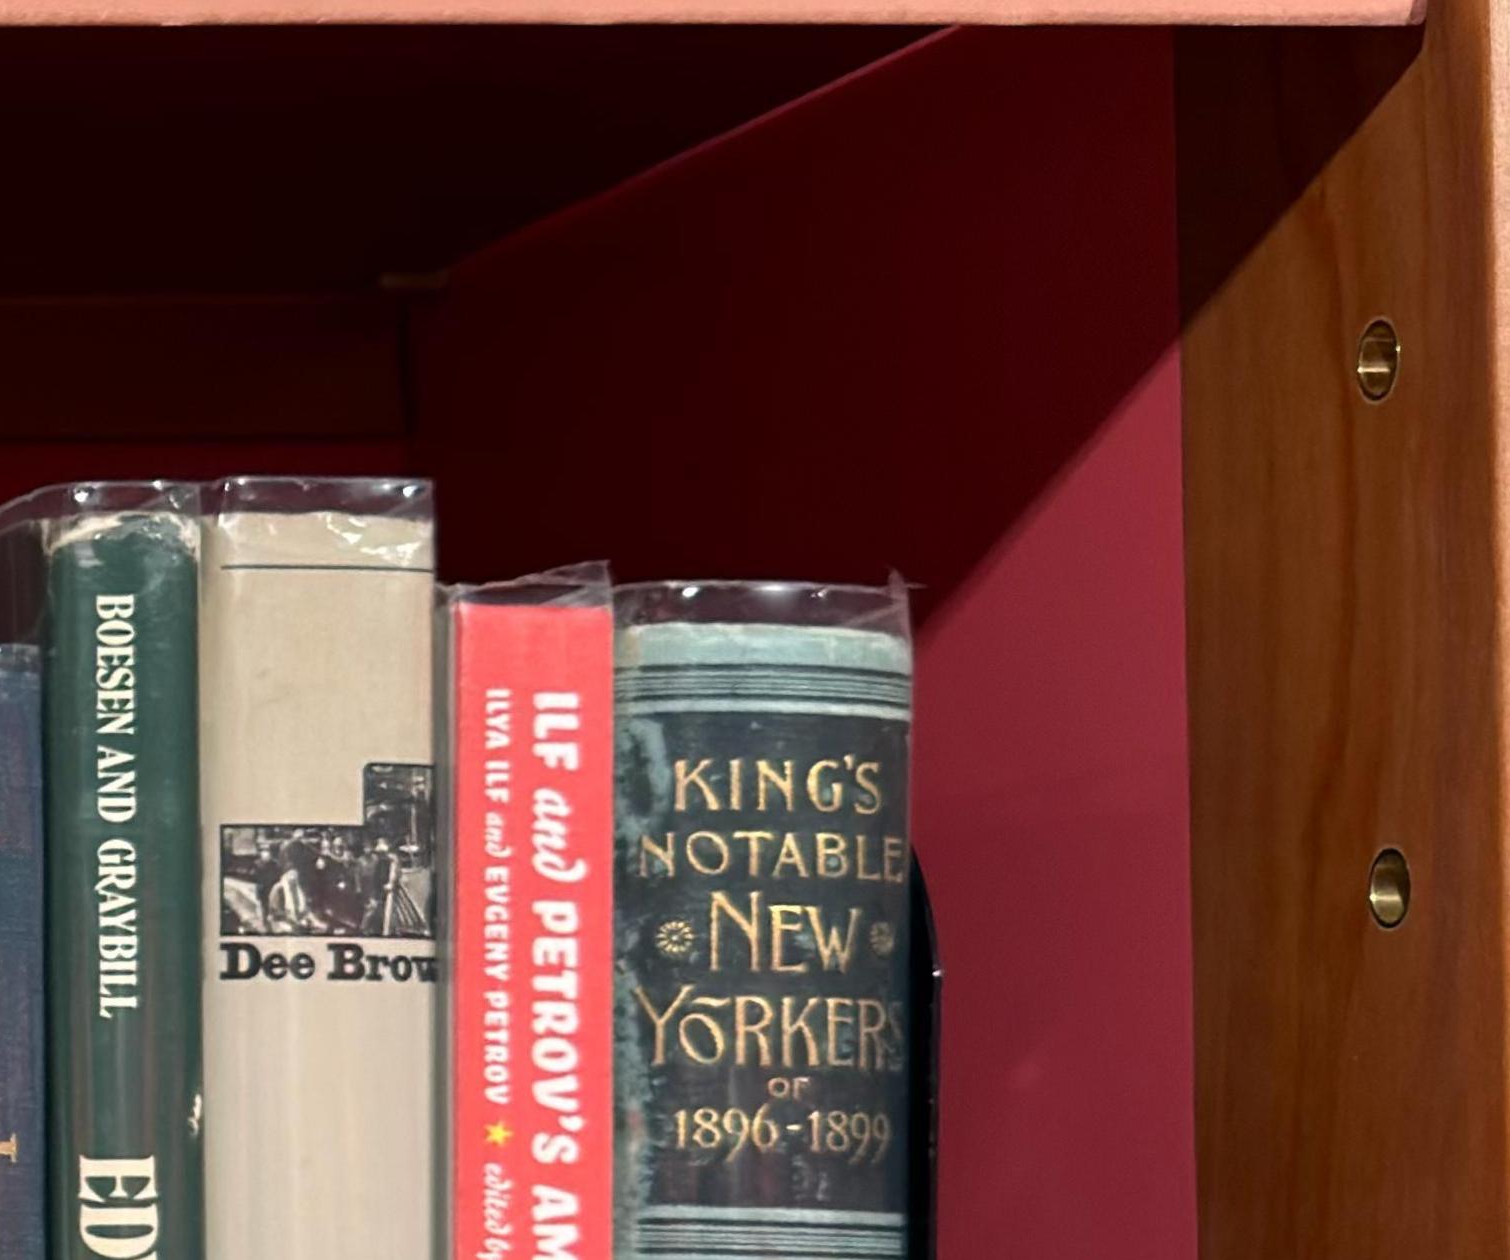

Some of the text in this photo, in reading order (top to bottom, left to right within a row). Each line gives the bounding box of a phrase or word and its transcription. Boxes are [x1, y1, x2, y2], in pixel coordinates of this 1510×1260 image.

[532, 690, 582, 772] ILF
[93, 593, 140, 1019] BOESEN AND GRAYBILL
[531, 786, 588, 884] and
[638, 830, 905, 884] NOTABLE
[708, 889, 864, 975] NEW
[673, 1106, 891, 1165] 1896-1899
